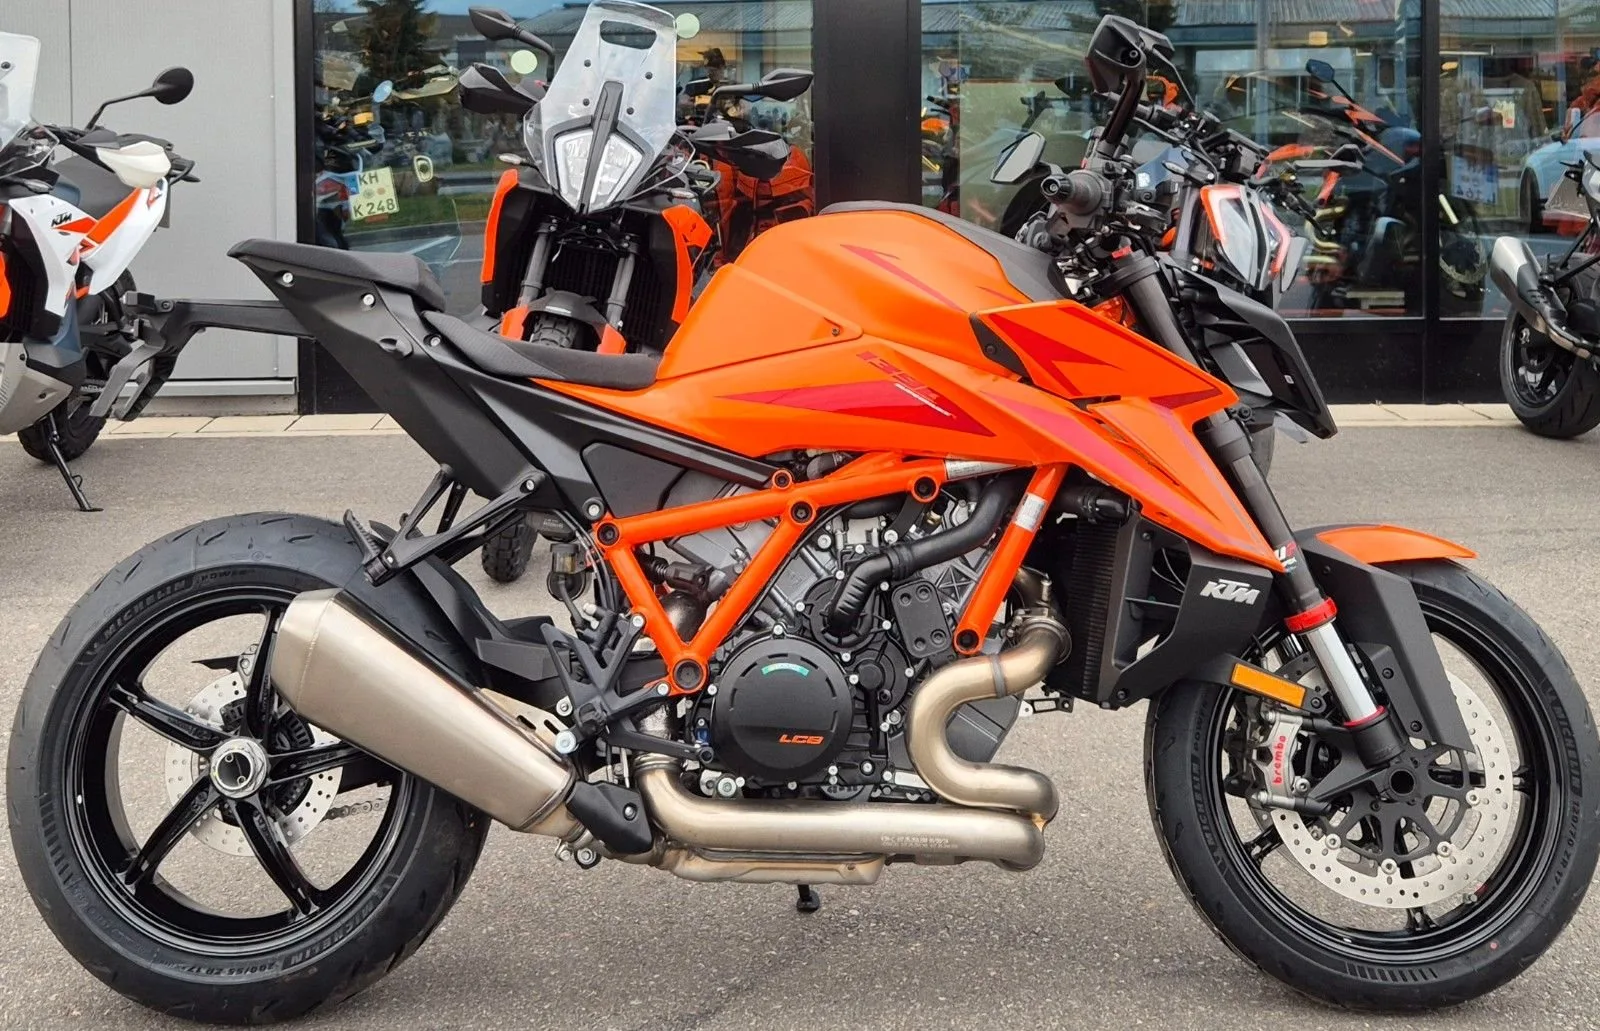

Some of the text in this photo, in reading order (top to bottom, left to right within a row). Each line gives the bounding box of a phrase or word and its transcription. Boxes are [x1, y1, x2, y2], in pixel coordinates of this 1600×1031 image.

[359, 171, 379, 186] KH
[51, 212, 72, 227] KTM
[353, 198, 396, 218] K 248
[1199, 578, 1260, 605] KTM
[103, 577, 187, 640] MICHELIN
[779, 734, 824, 745] LC8
[1273, 735, 1286, 784] brembo
[1567, 801, 1581, 847] 120/70
[290, 902, 377, 966] MICHELIN
